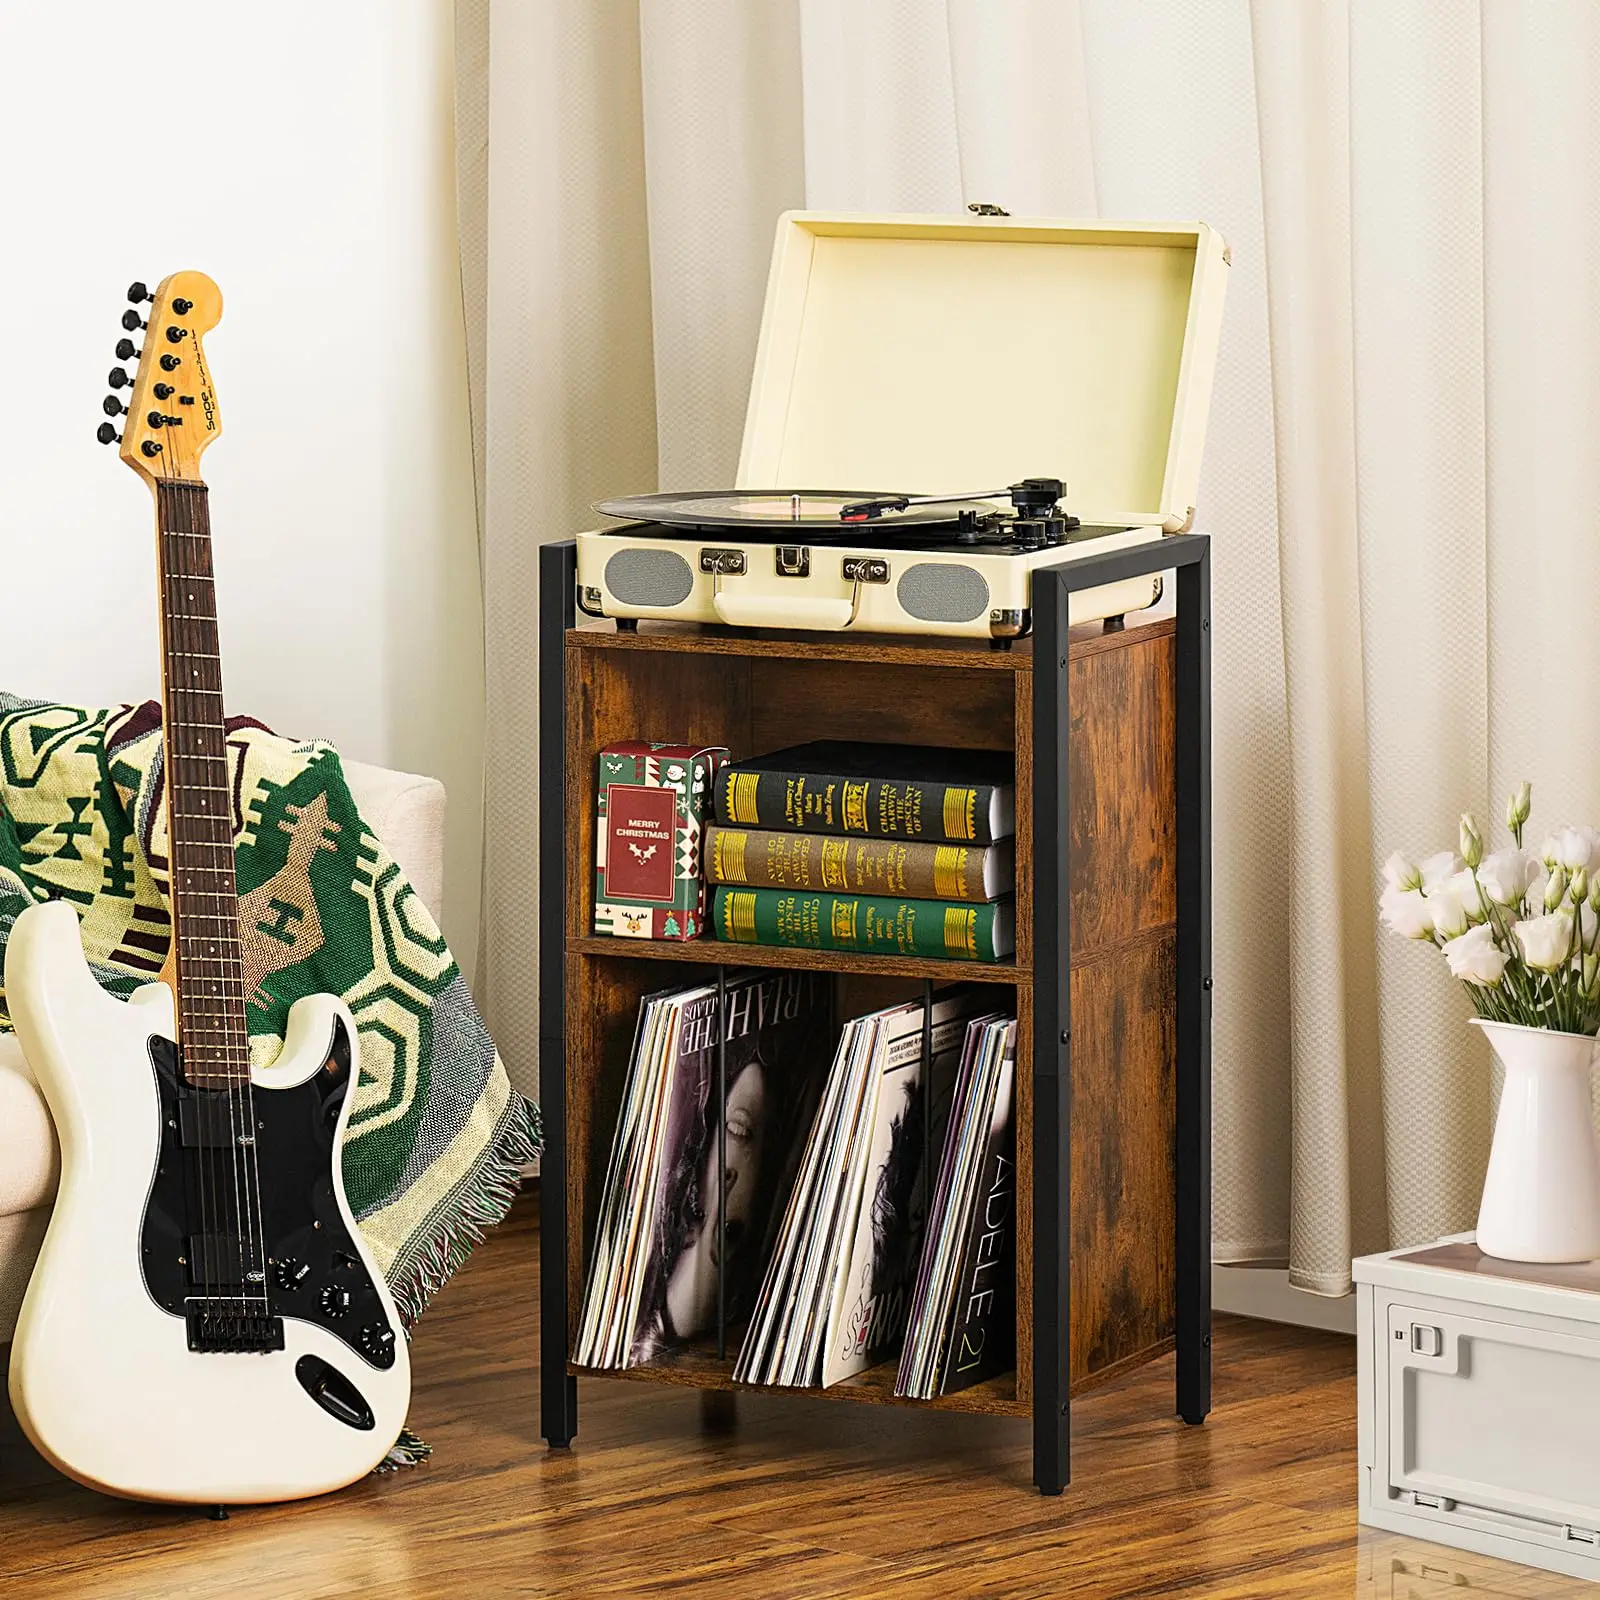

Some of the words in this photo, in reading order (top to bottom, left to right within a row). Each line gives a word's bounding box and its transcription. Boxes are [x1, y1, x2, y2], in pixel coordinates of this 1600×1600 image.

[880, 783, 889, 833] CHARLES
[888, 787, 897, 831] DARWIN
[896, 798, 904, 820] THE
[904, 785, 914, 835] DESCENT
[913, 790, 922, 815] MAN
[616, 828, 670, 840] CHRISTMAS
[628, 819, 660, 829] MERRY
[914, 817, 922, 832] OF
[777, 900, 785, 914] OF
[965, 1155, 1014, 1325] ADELE
[956, 1328, 986, 1373] 21
